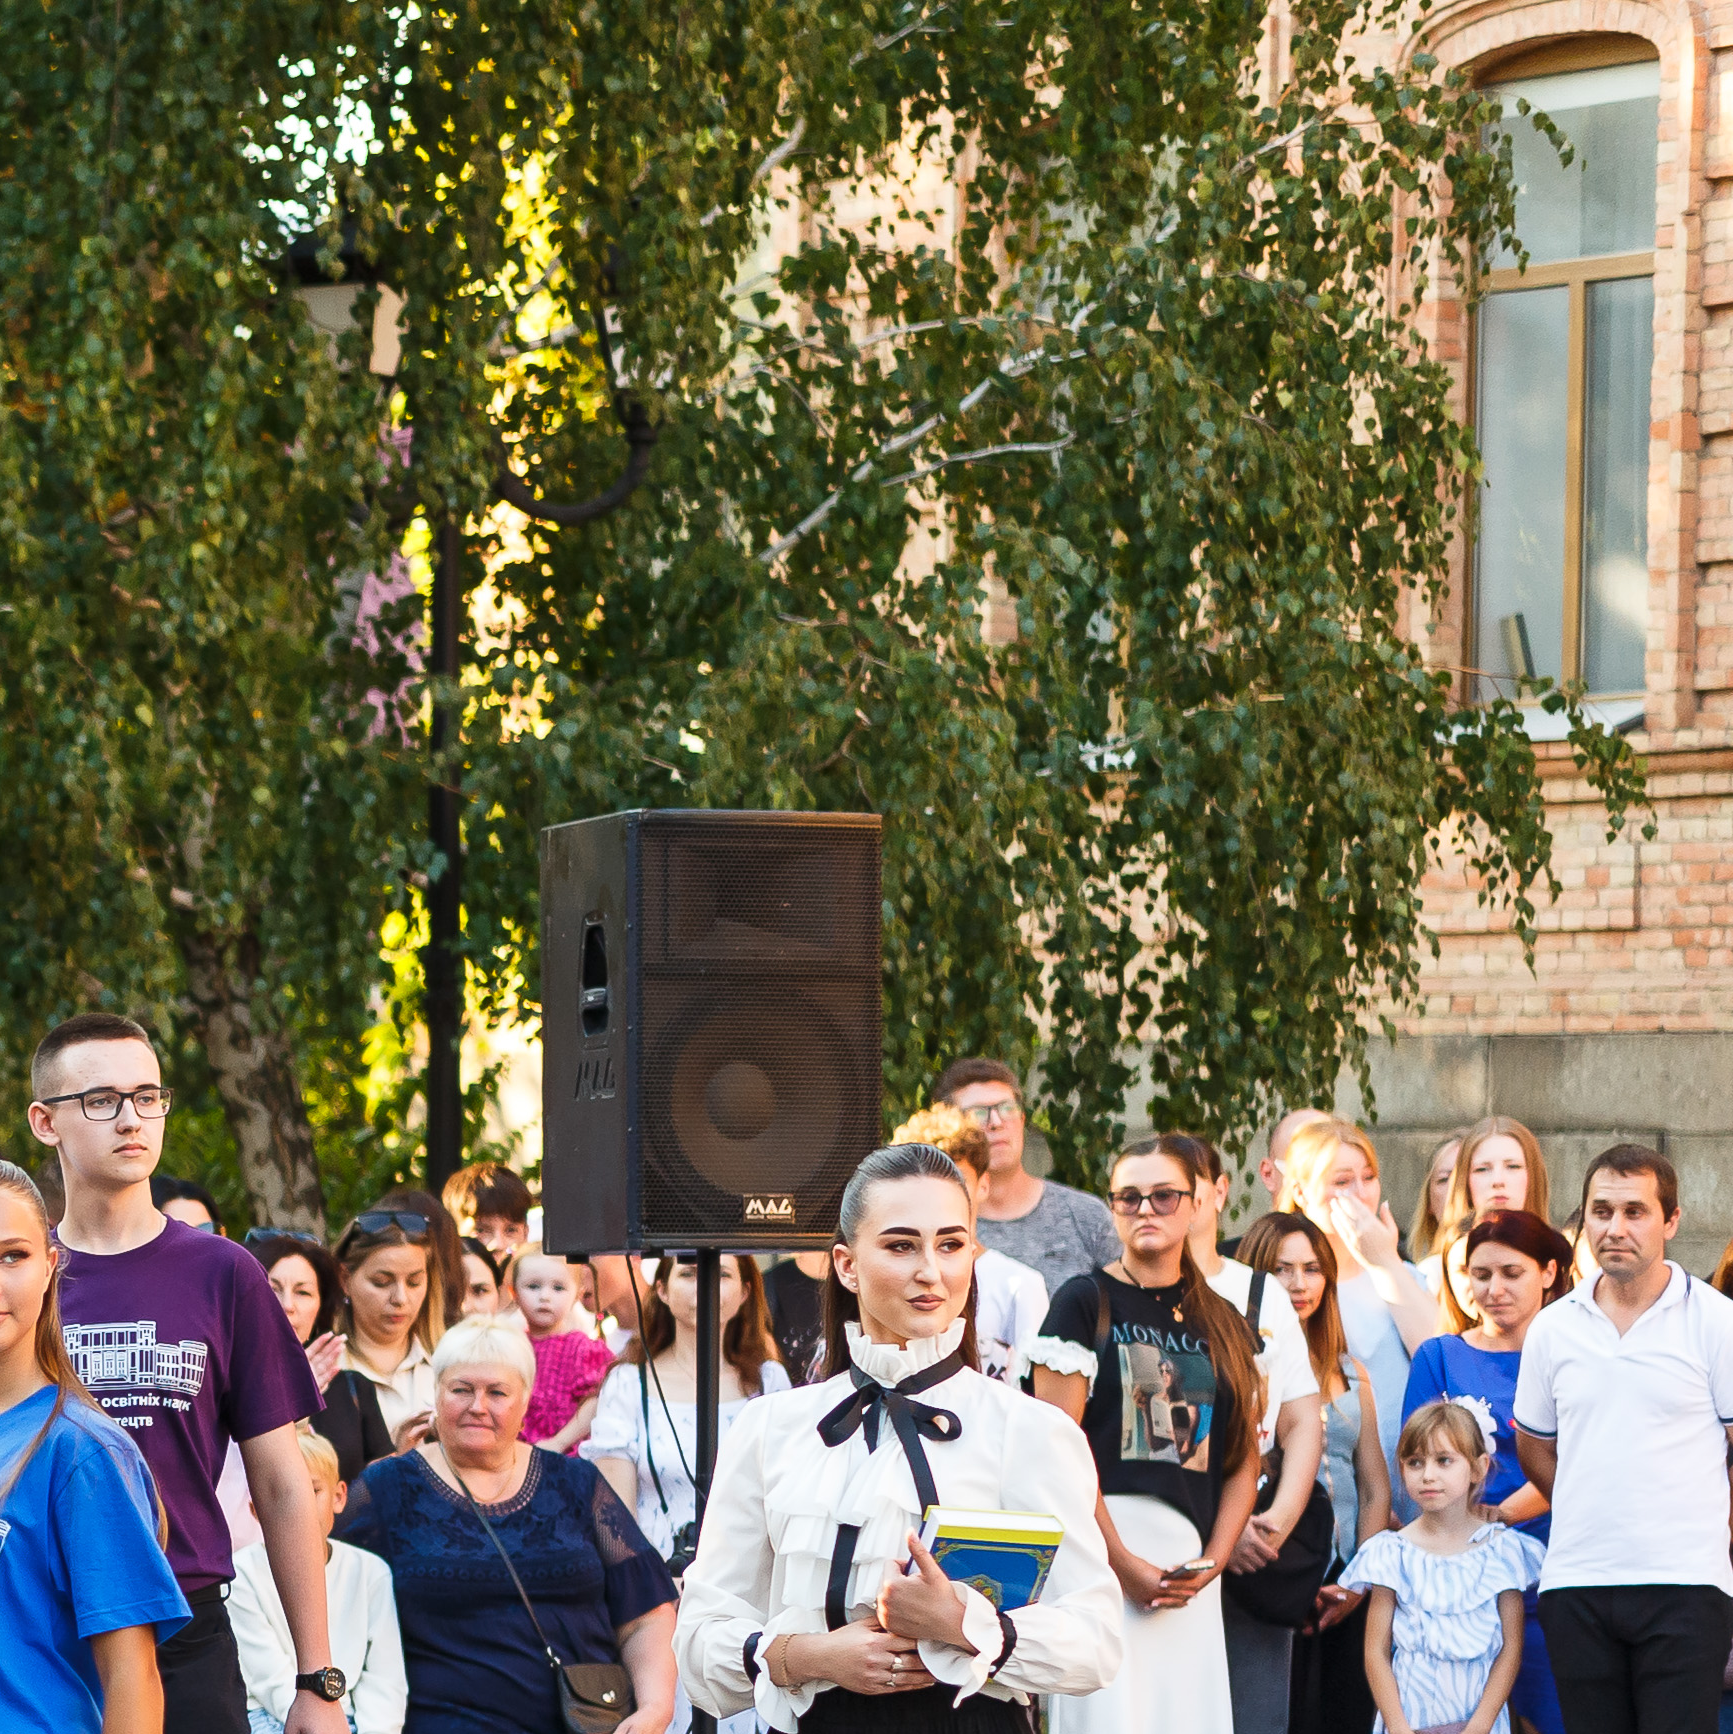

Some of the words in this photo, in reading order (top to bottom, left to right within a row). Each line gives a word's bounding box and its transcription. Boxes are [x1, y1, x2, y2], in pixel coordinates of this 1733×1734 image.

[745, 1198, 792, 1215] MAG
[101, 1393, 160, 1408] освітніх
[115, 1416, 154, 1429] тецтв
